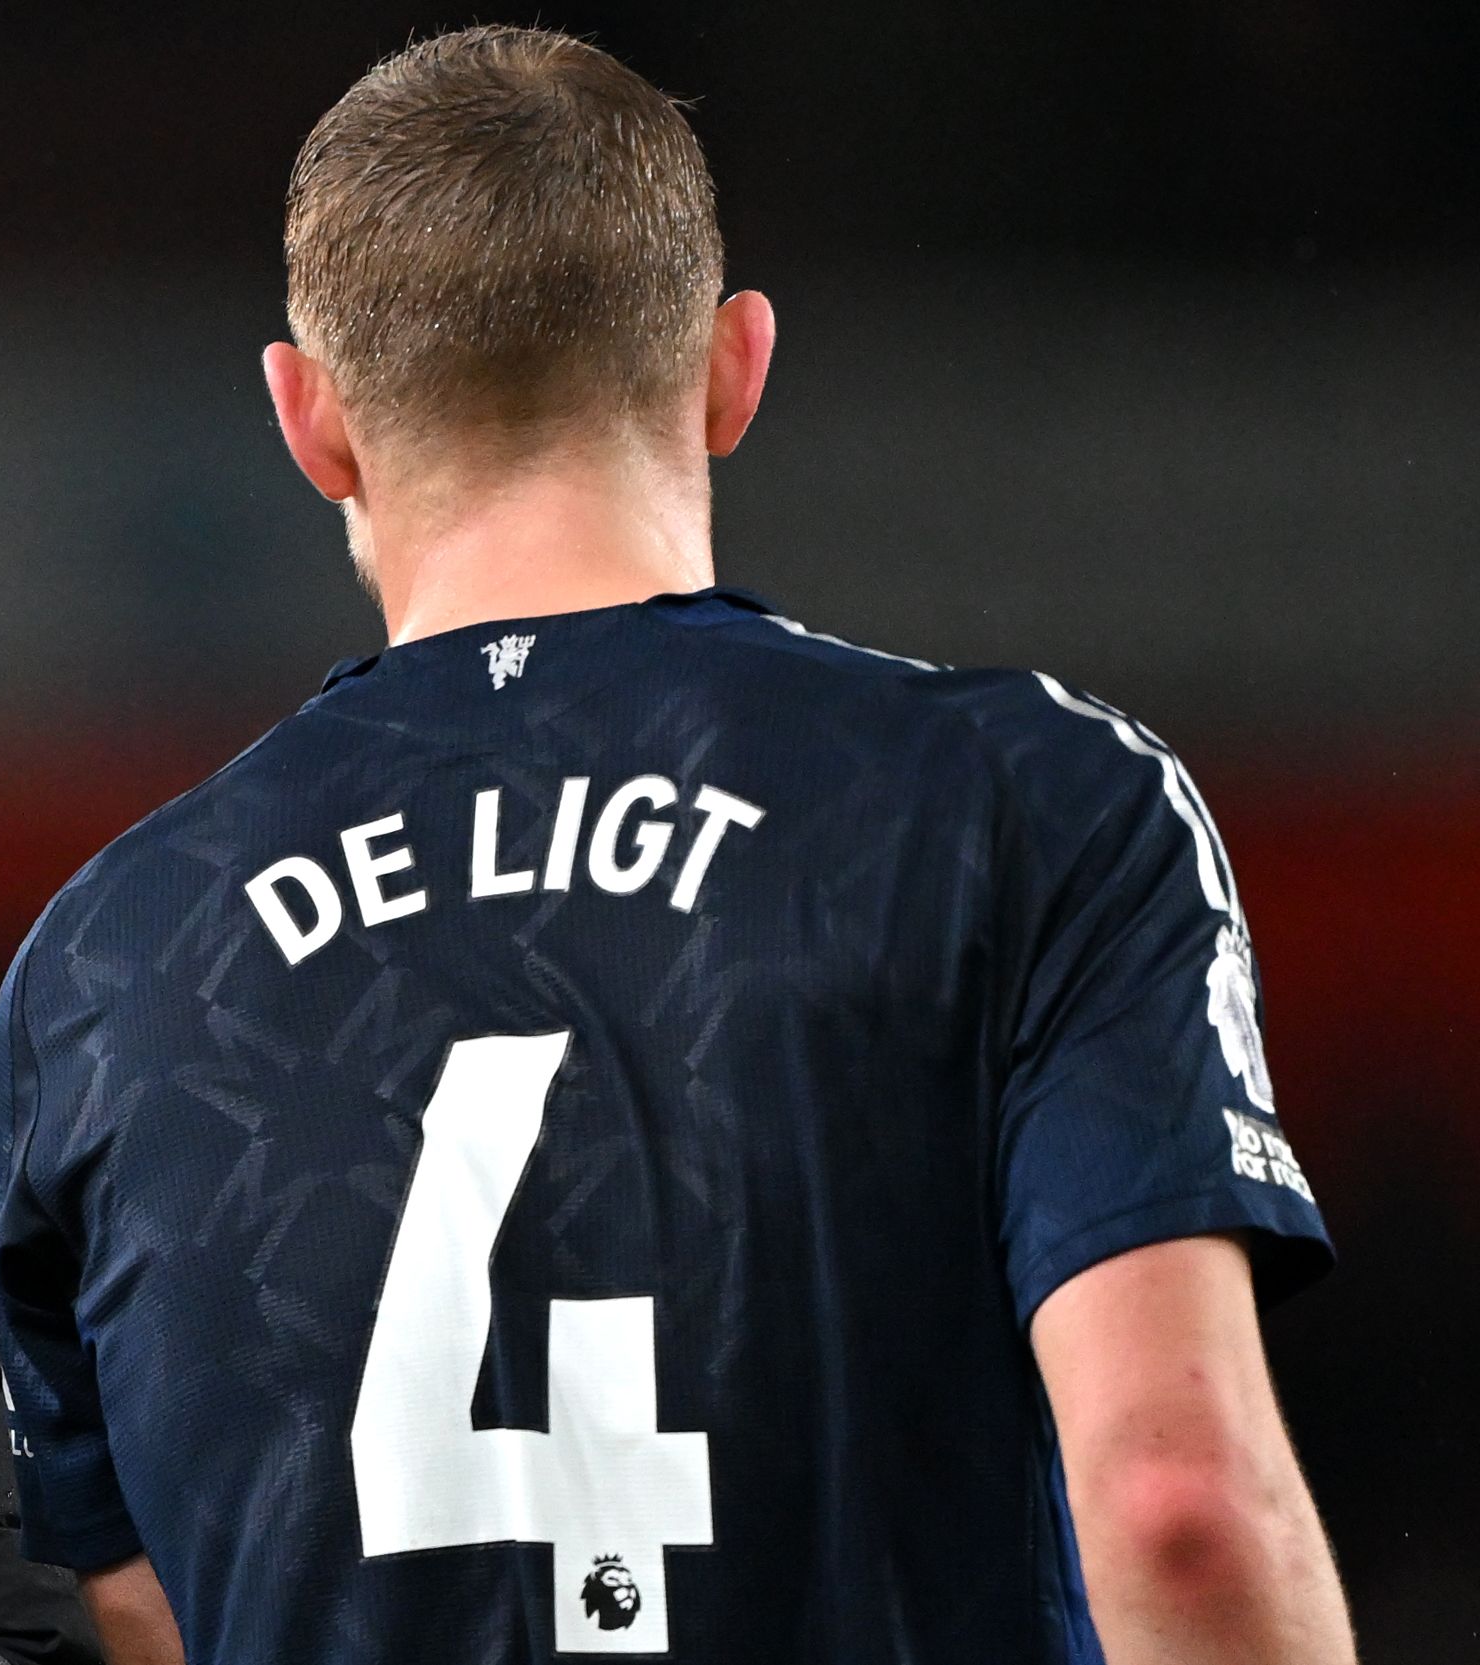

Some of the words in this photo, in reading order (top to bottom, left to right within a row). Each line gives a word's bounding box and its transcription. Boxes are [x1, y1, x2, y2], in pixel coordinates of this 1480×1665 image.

[246, 810, 427, 967] DE
[471, 775, 764, 913] LIGT
[352, 1030, 713, 1653] 4
